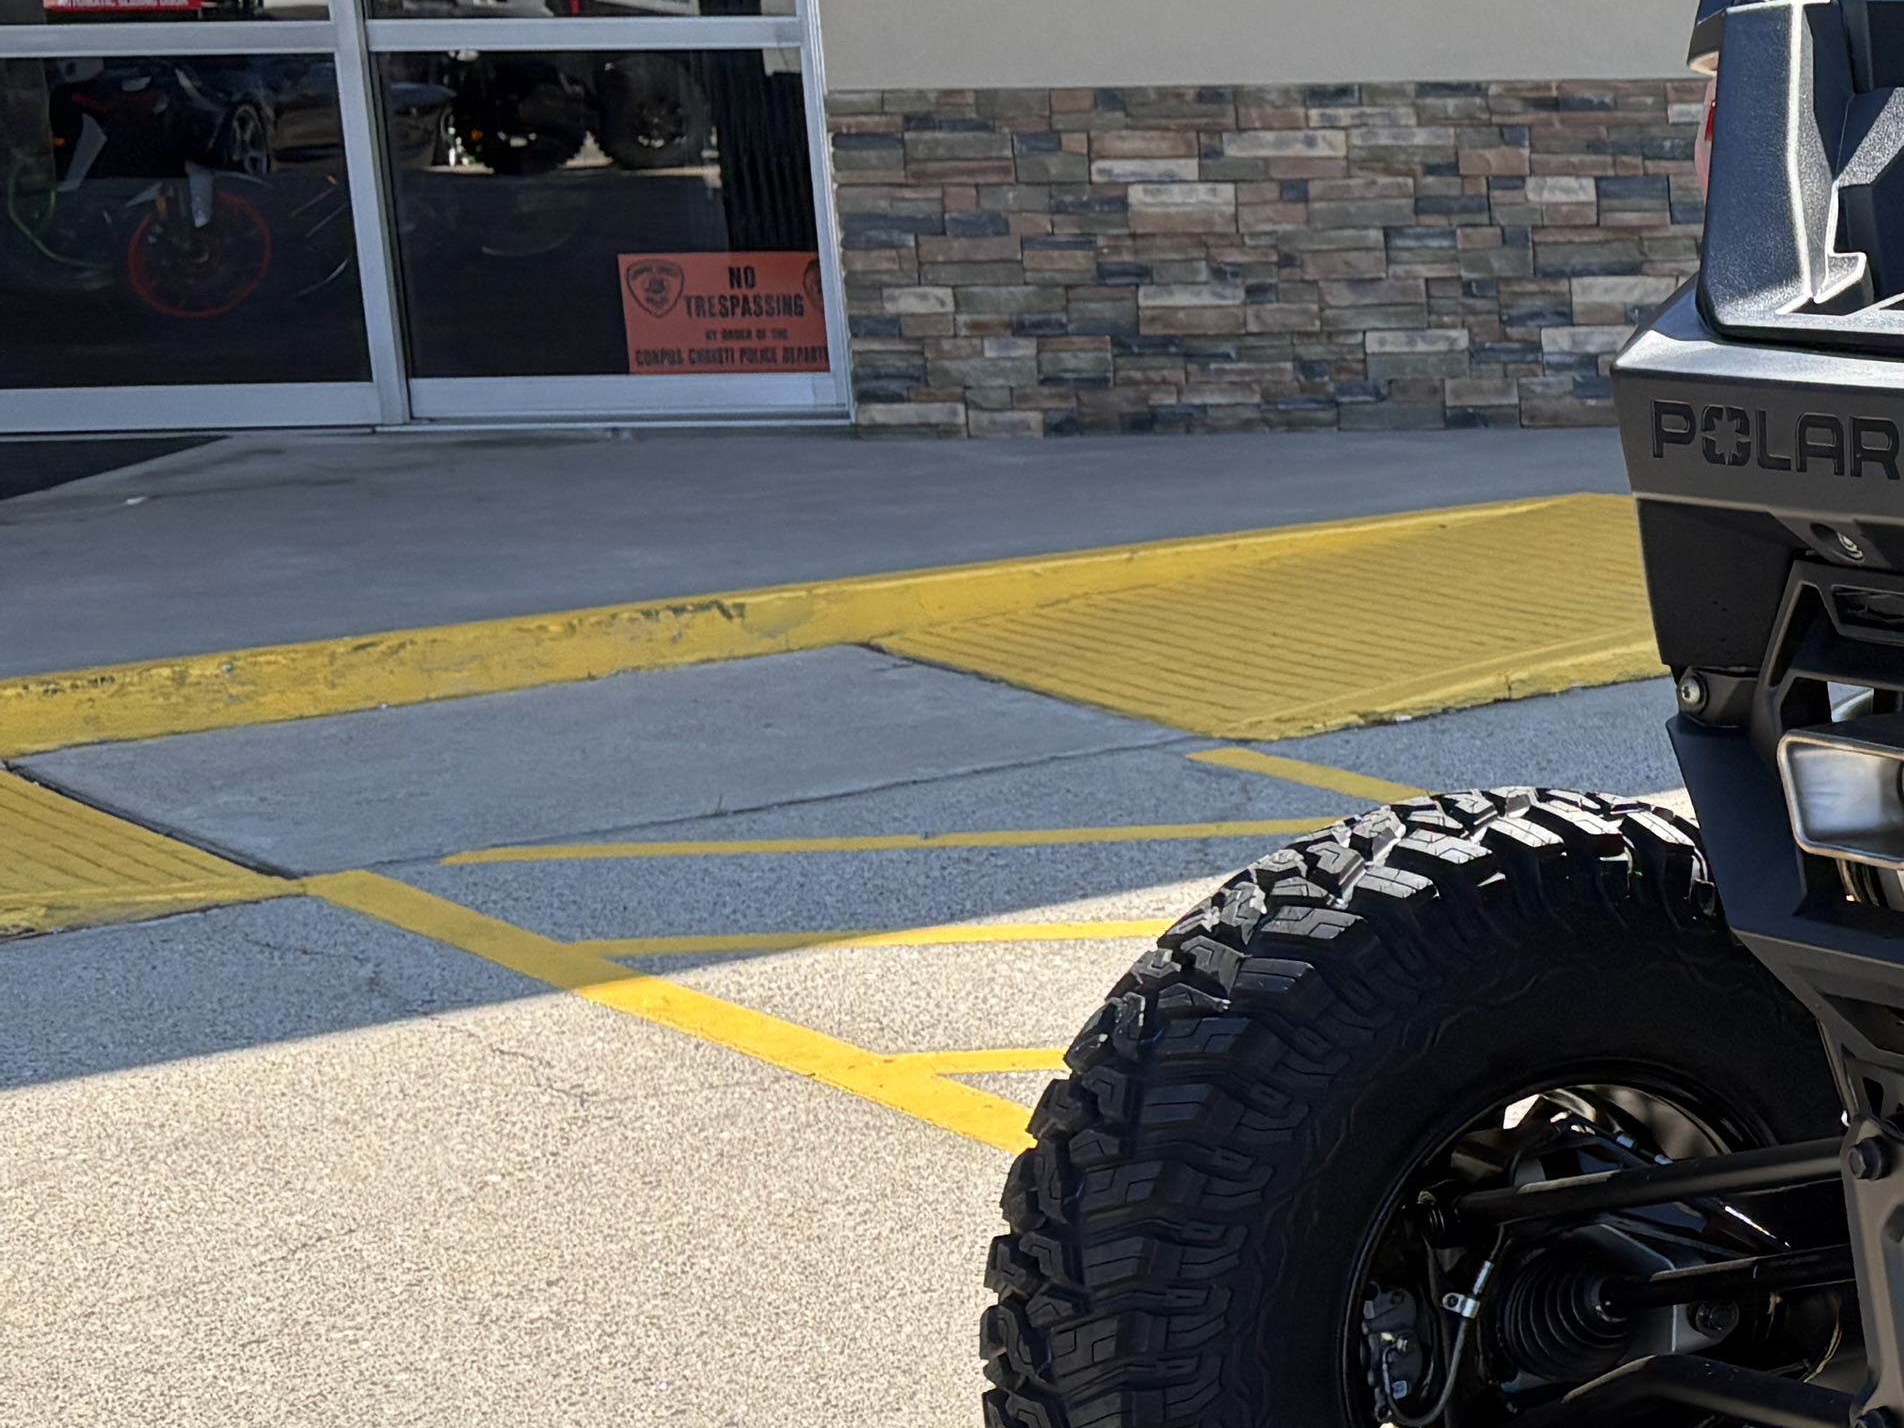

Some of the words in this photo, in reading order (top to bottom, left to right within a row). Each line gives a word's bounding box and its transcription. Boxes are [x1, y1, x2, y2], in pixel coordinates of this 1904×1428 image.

[728, 266, 756, 289] NO
[684, 293, 804, 318] TRESPASSING
[635, 348, 684, 367] CORPUS
[689, 347, 735, 365] CHRISTI
[740, 346, 778, 364] POLICE
[782, 345, 829, 364] DEPART
